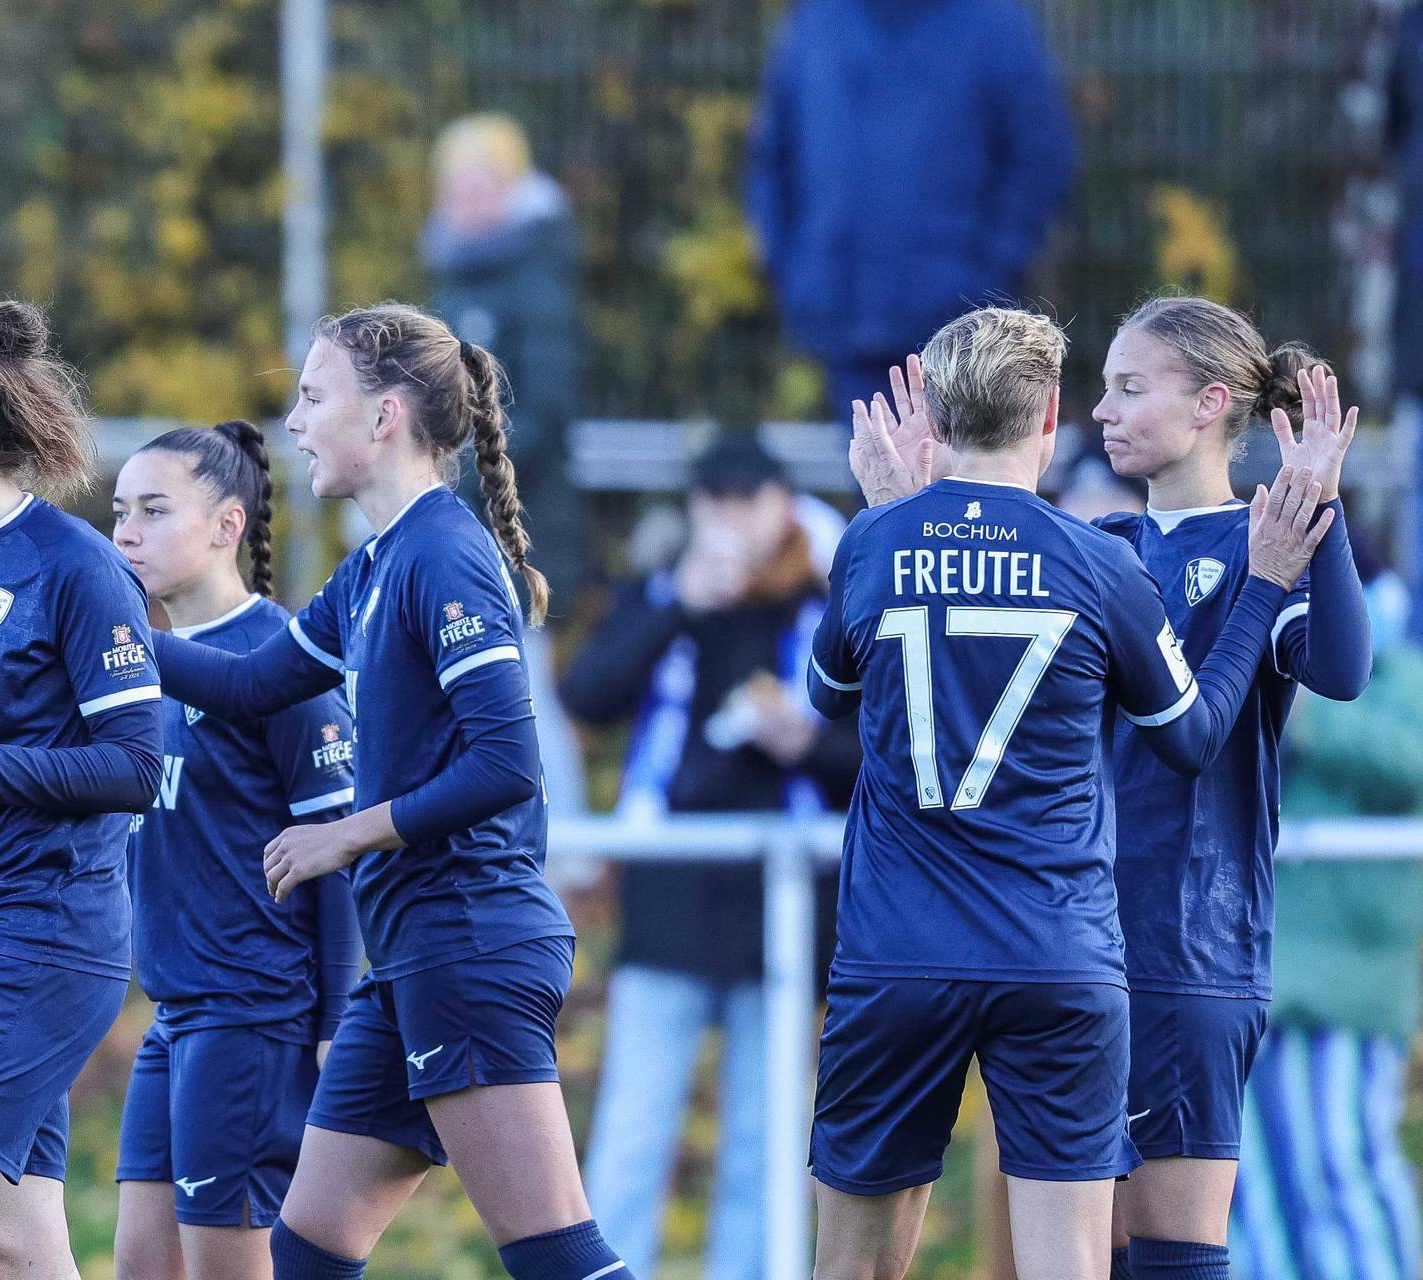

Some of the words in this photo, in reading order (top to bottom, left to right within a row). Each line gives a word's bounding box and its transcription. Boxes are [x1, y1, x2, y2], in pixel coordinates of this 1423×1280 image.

[922, 522, 1018, 541] BOCHUM
[893, 549, 1050, 597] FREUTEL
[439, 615, 486, 647] FIEGE
[101, 644, 146, 671] FIEGE
[112, 643, 136, 653] MORITZ
[874, 605, 1079, 812] 17
[312, 740, 354, 768] FIEGE
